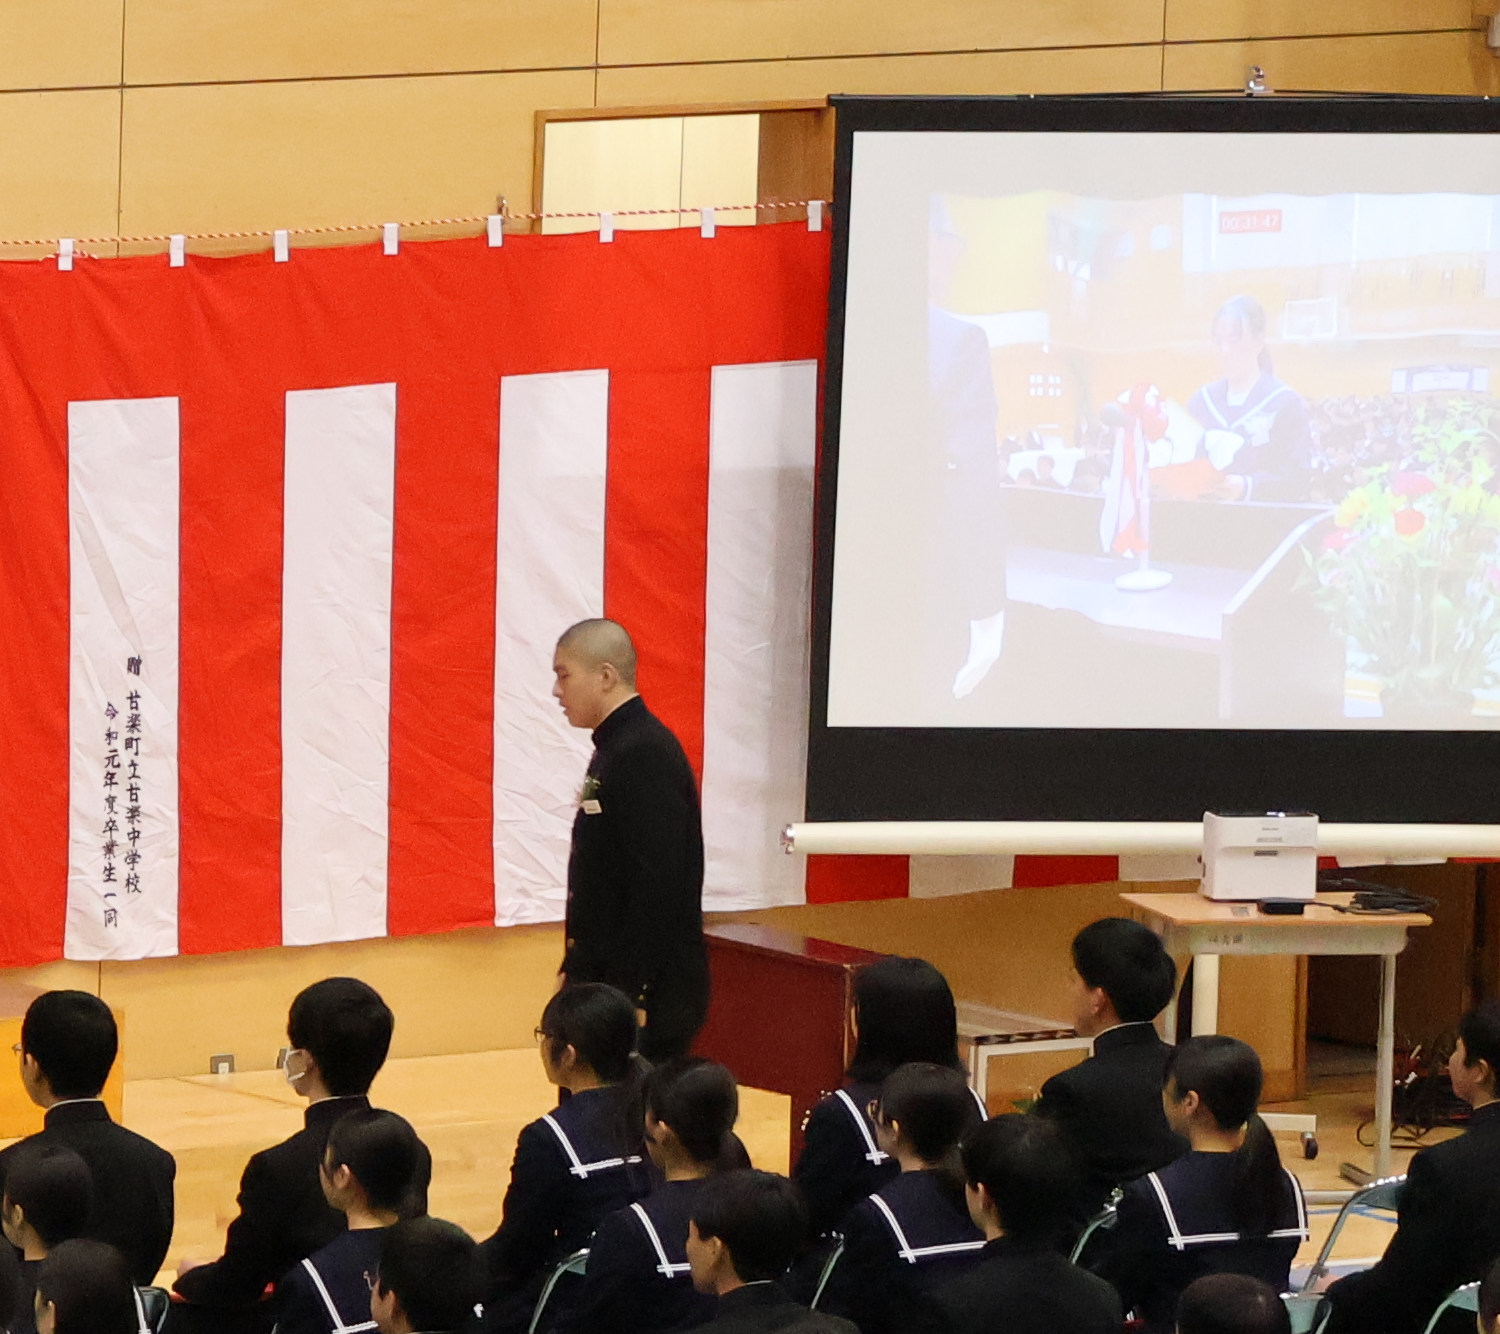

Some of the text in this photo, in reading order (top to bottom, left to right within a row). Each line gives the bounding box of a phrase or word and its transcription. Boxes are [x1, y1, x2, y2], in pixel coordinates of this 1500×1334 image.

[102, 701, 121, 928] 令和元年度卒業生一同
[124, 689, 142, 894] 甘楽町立甘楽中学校
